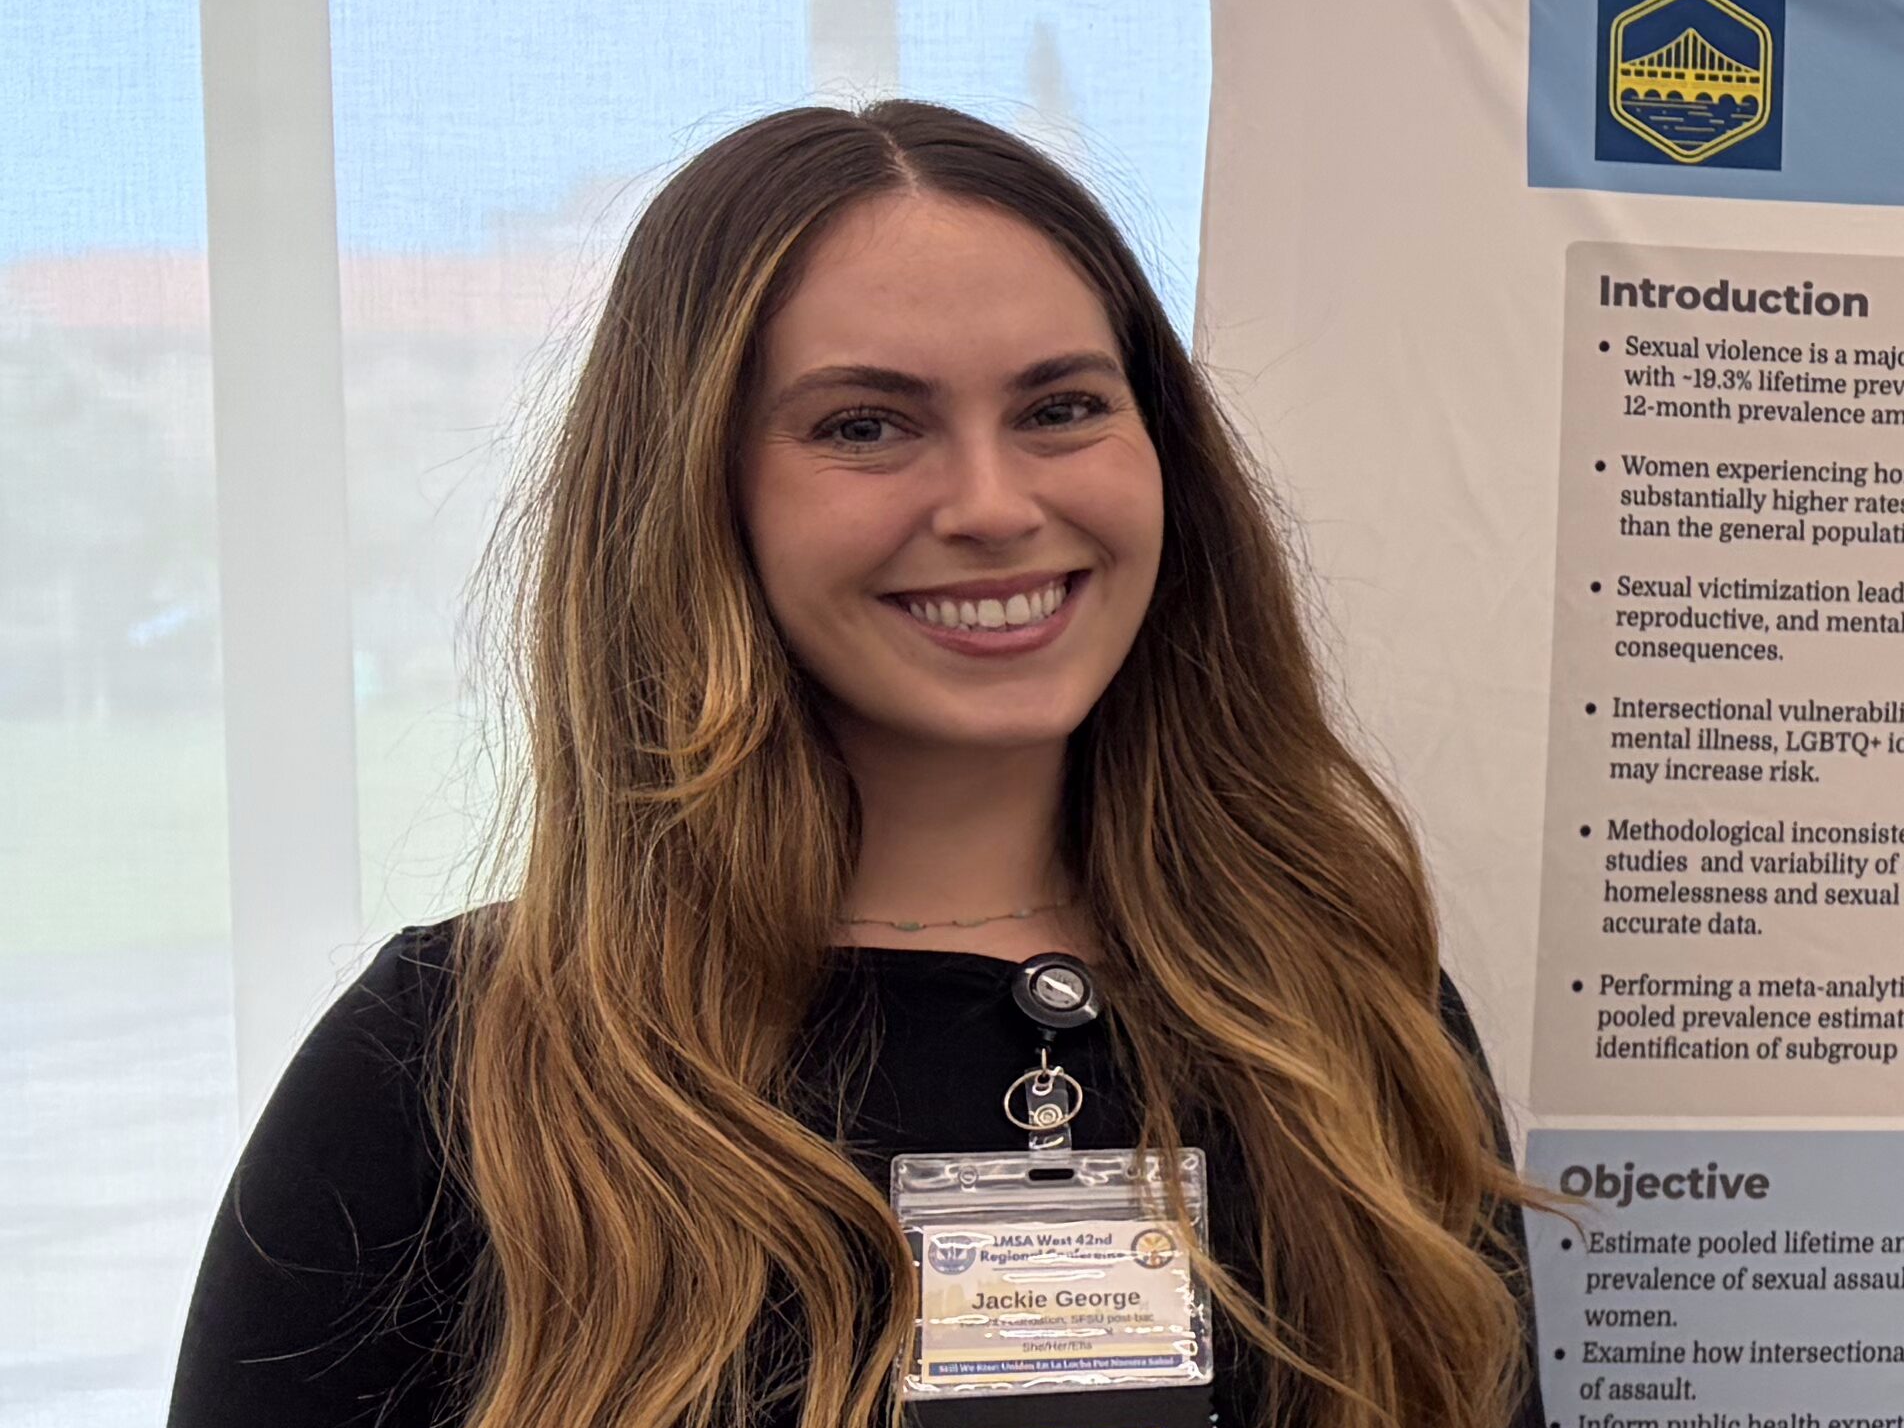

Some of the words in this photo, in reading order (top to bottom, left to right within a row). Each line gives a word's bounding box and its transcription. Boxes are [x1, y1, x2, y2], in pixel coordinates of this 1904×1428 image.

[1599, 274, 1869, 318] Introduction
[1625, 334, 1700, 360] Sexual
[1705, 337, 1803, 365] violence
[1808, 341, 1829, 365] is
[1834, 348, 1848, 366] a
[1559, 1162, 1770, 1207] Objective
[1036, 1233, 1073, 1247] West
[1075, 1232, 1113, 1246] 42nd
[1589, 1229, 1692, 1256] Estimate
[1697, 1229, 1777, 1260] pooled
[1783, 1229, 1875, 1255] lifetime
[972, 1290, 1047, 1310] Jackie
[1055, 1289, 1141, 1312] George
